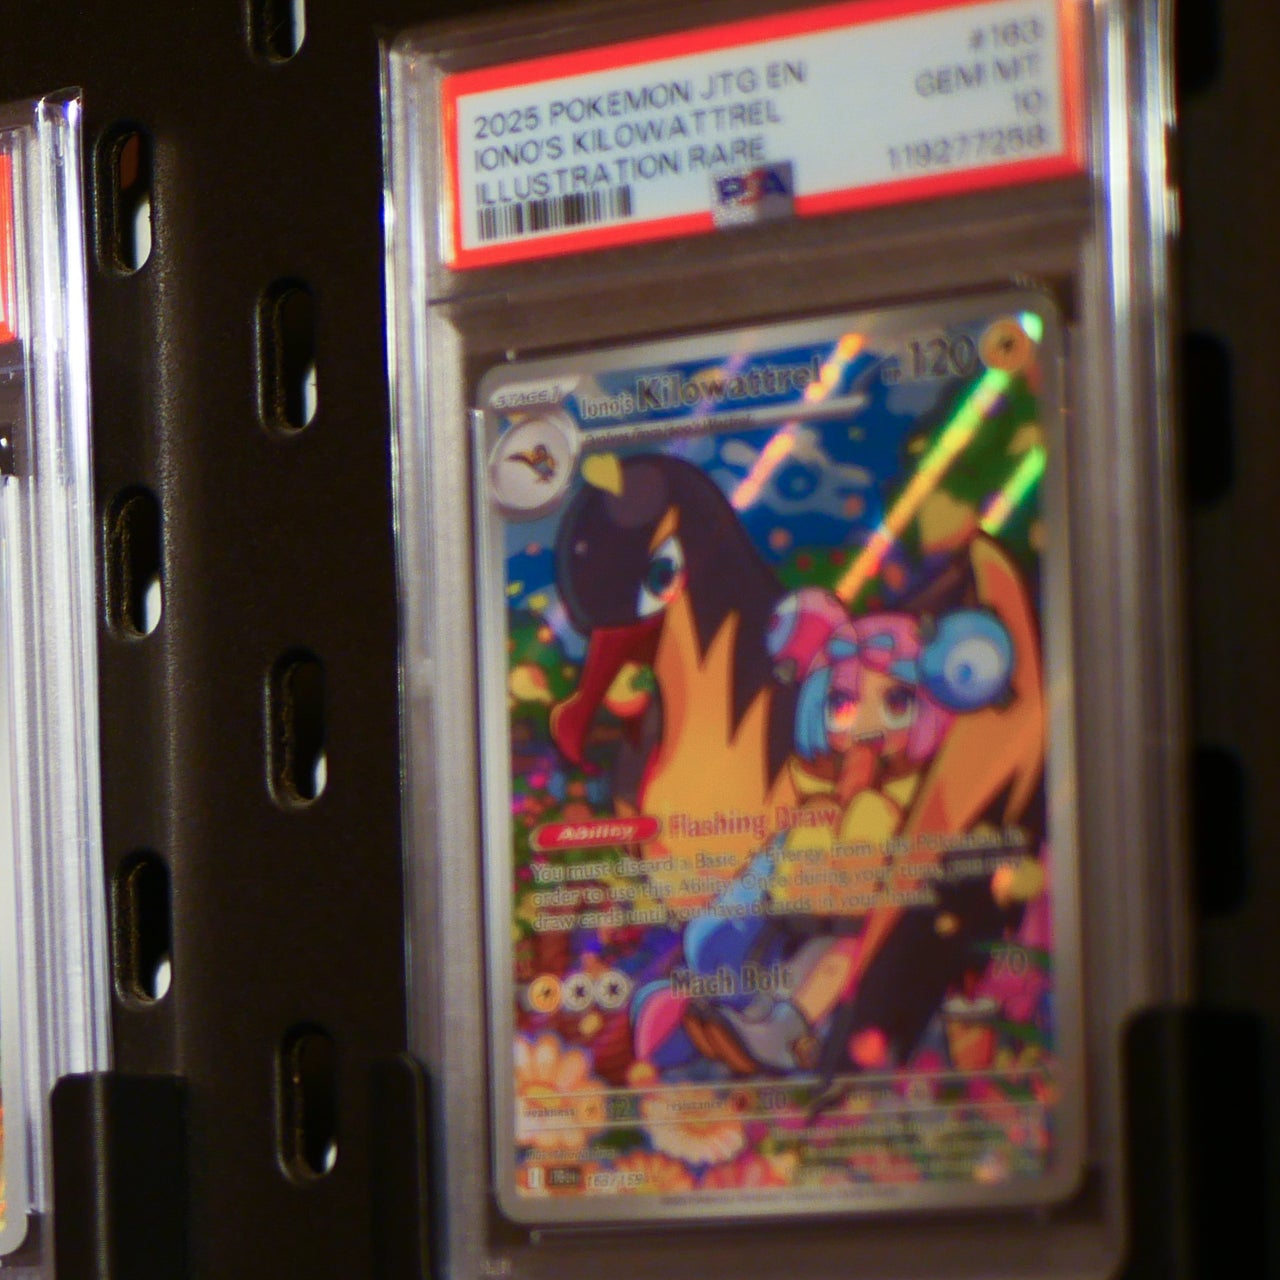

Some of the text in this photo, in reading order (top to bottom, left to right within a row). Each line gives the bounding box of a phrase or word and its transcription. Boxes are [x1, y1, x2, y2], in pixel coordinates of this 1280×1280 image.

[474, 62, 805, 140] 2025 POKEMON JTG EN
[573, 100, 780, 153] KILOWATTREL
[476, 136, 765, 205] ILLUSTRATION RARE
[637, 354, 820, 411] Kilowattrel
[668, 811, 766, 840] Flashing
